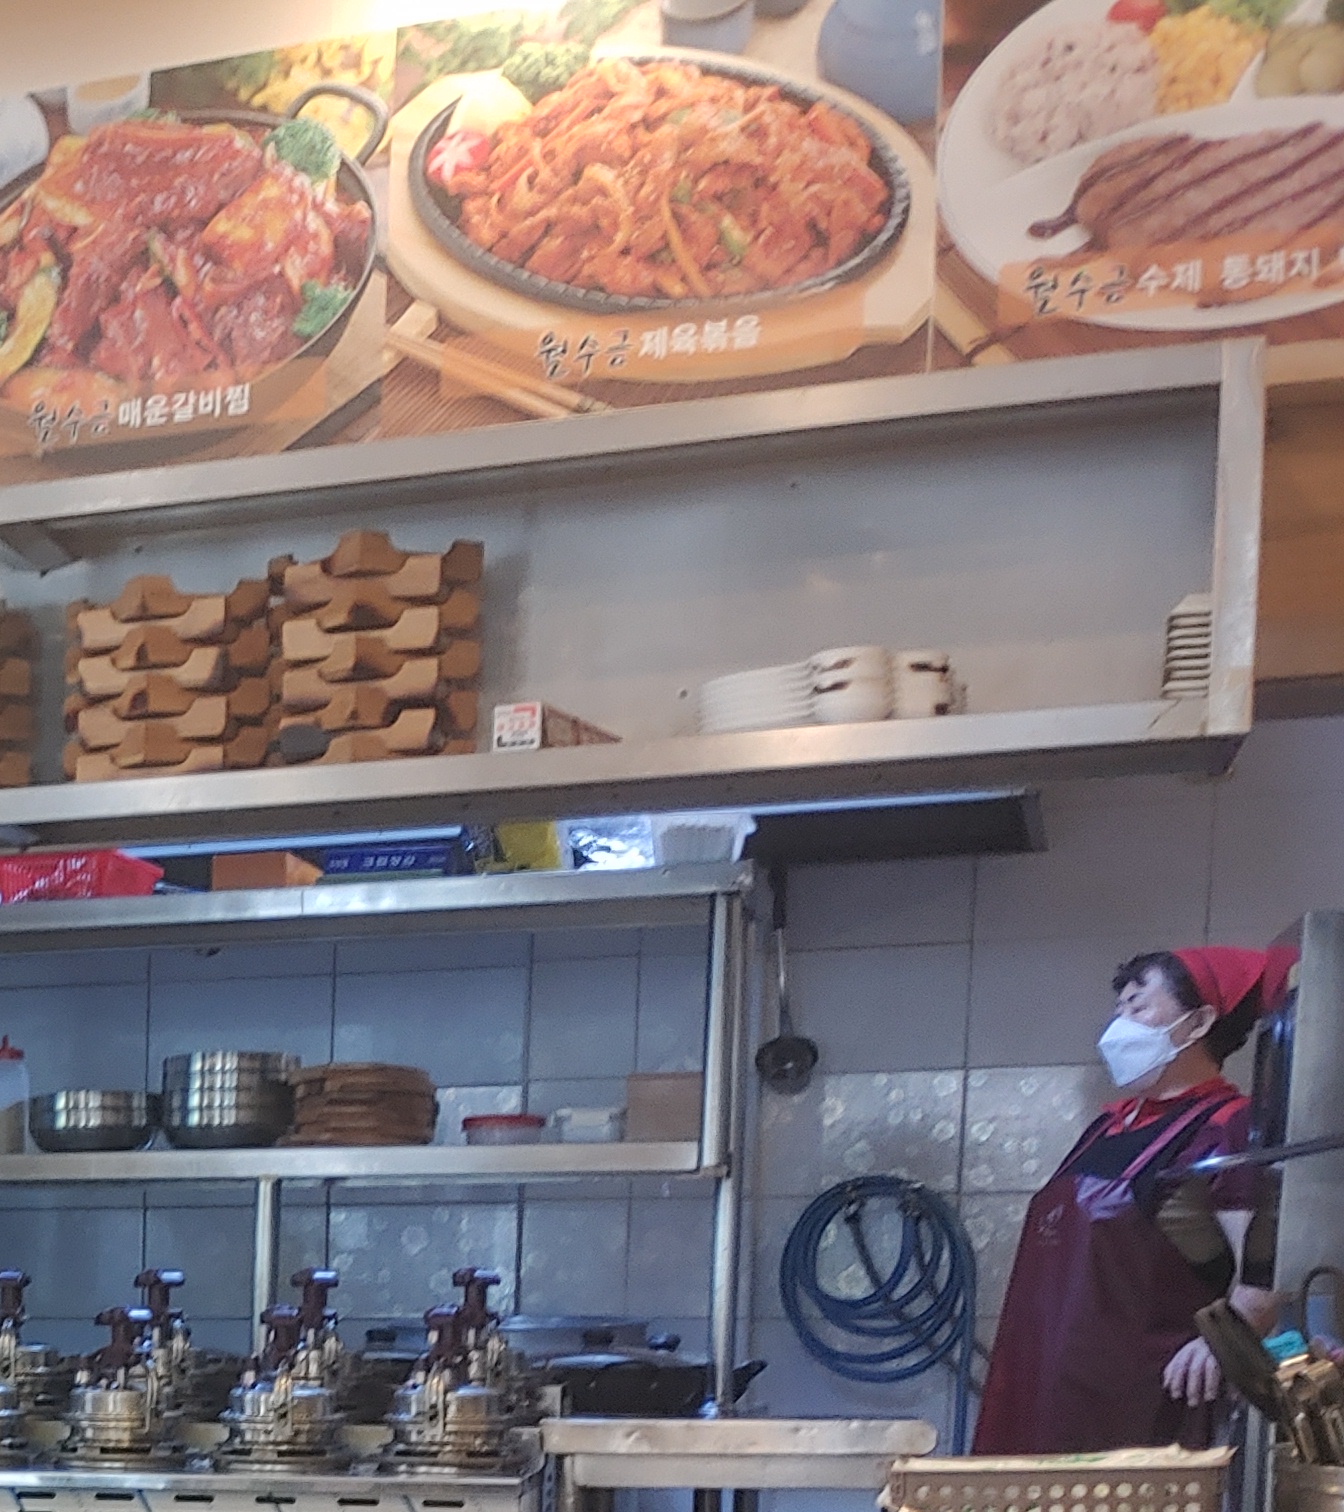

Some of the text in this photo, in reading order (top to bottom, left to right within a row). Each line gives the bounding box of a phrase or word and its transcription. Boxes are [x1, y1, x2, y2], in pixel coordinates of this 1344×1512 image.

[1136, 259, 1202, 297] 수제
[1221, 247, 1320, 290] 통돼지
[639, 314, 761, 360] 제육볶음
[118, 382, 250, 428] 매운갈비찜
